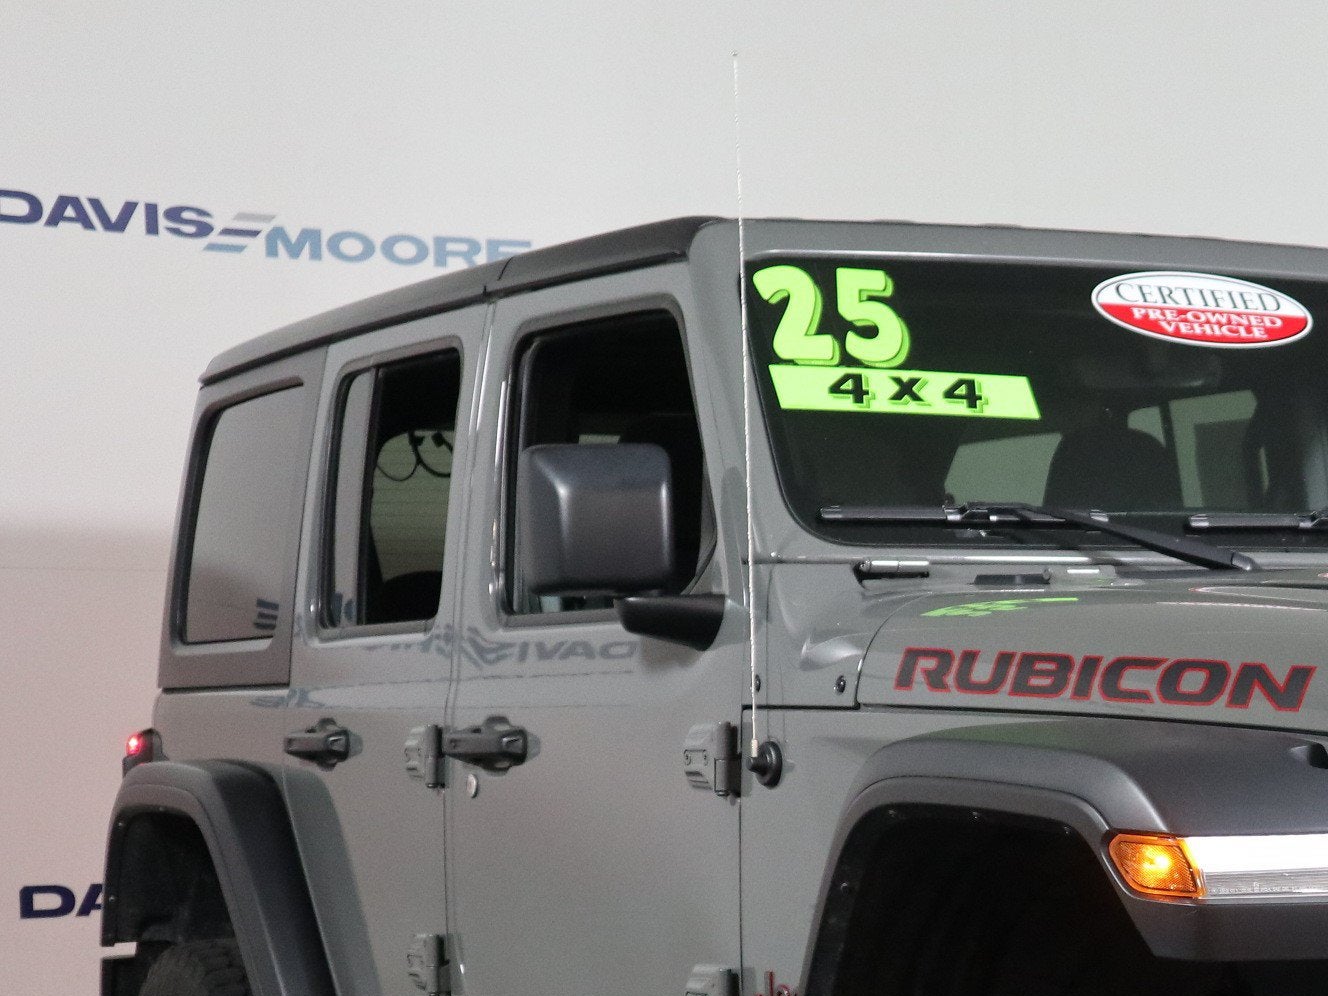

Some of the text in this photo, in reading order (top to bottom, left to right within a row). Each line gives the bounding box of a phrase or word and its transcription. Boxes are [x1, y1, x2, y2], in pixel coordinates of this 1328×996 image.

[0, 189, 216, 239] DAVIS
[752, 265, 911, 368] 25
[1114, 282, 1282, 312] CERTIFIED
[1131, 306, 1284, 328] PRE-OWNED
[1159, 320, 1268, 339] VEHICLE
[893, 647, 1317, 713] RUBICON
